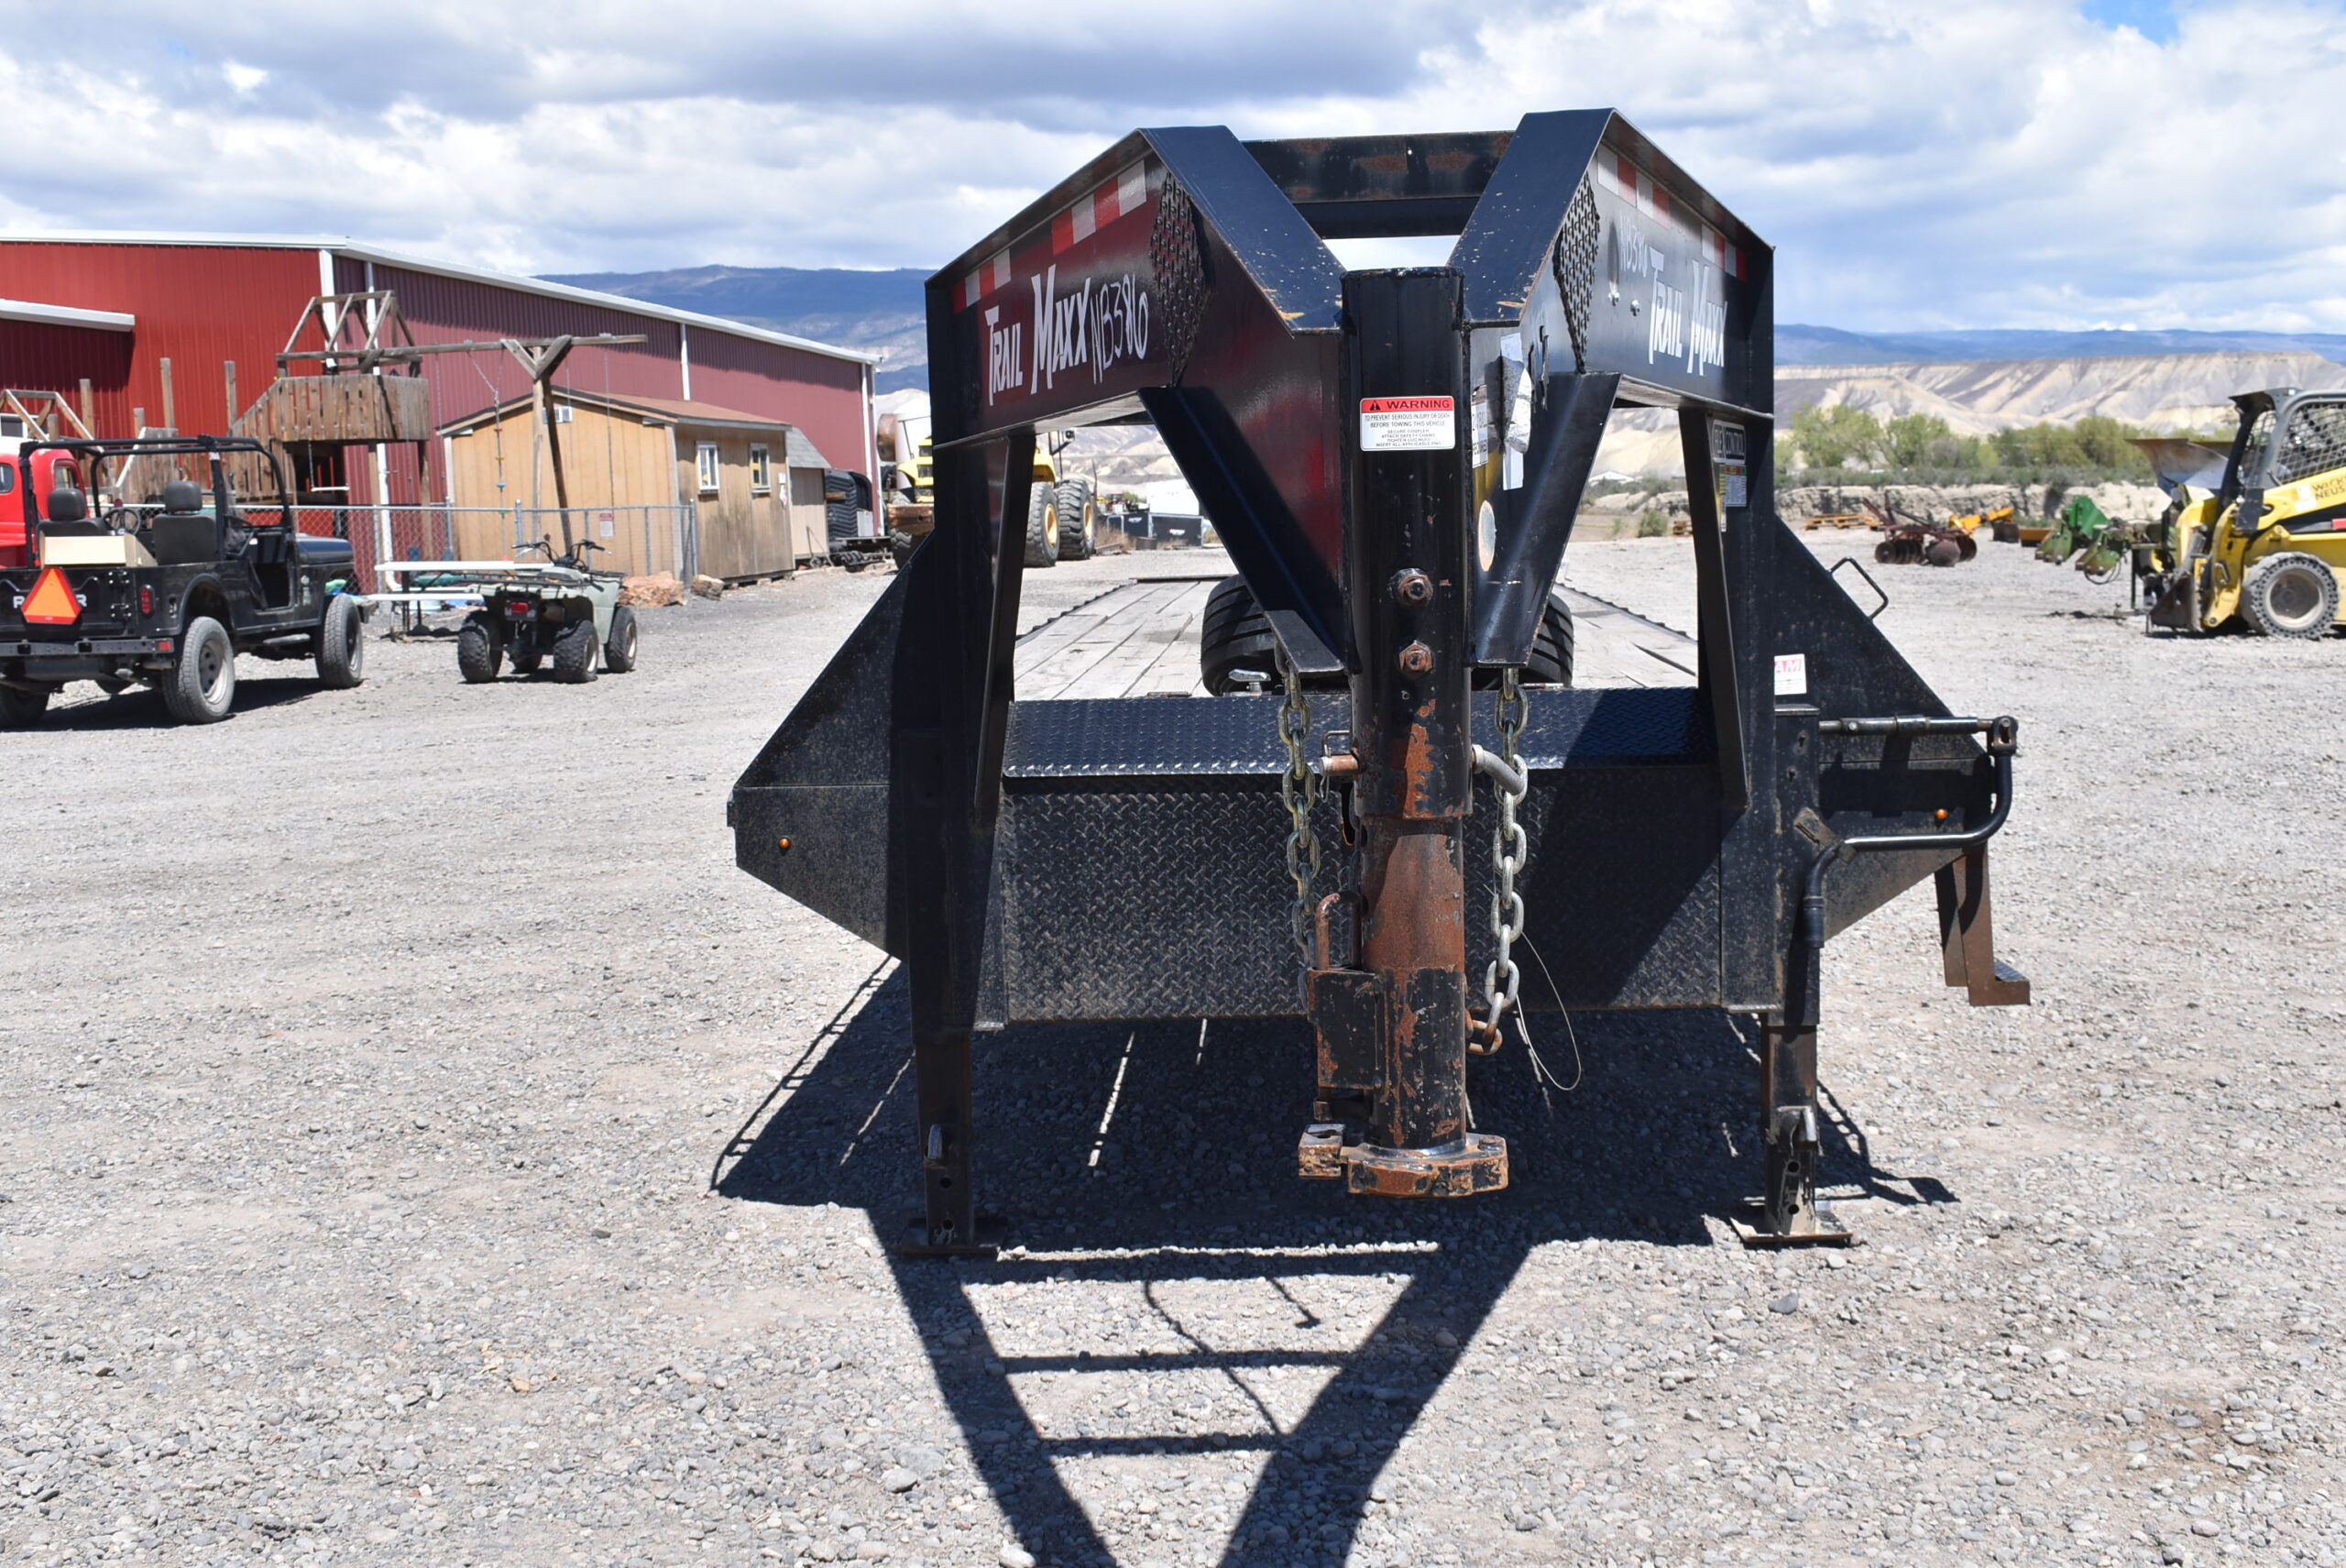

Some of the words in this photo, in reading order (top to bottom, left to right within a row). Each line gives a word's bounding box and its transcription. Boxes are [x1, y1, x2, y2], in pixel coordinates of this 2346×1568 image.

[1649, 246, 1683, 365] TRAIL
[1687, 259, 1728, 376] MAXX
[984, 305, 1024, 406] TRAIL
[1030, 264, 1091, 395] MAXX
[1386, 400, 1450, 409] WARNING
[2311, 476, 2346, 491] WACK
[2315, 485, 2346, 500] NEUS
[1774, 659, 1803, 674] AM
